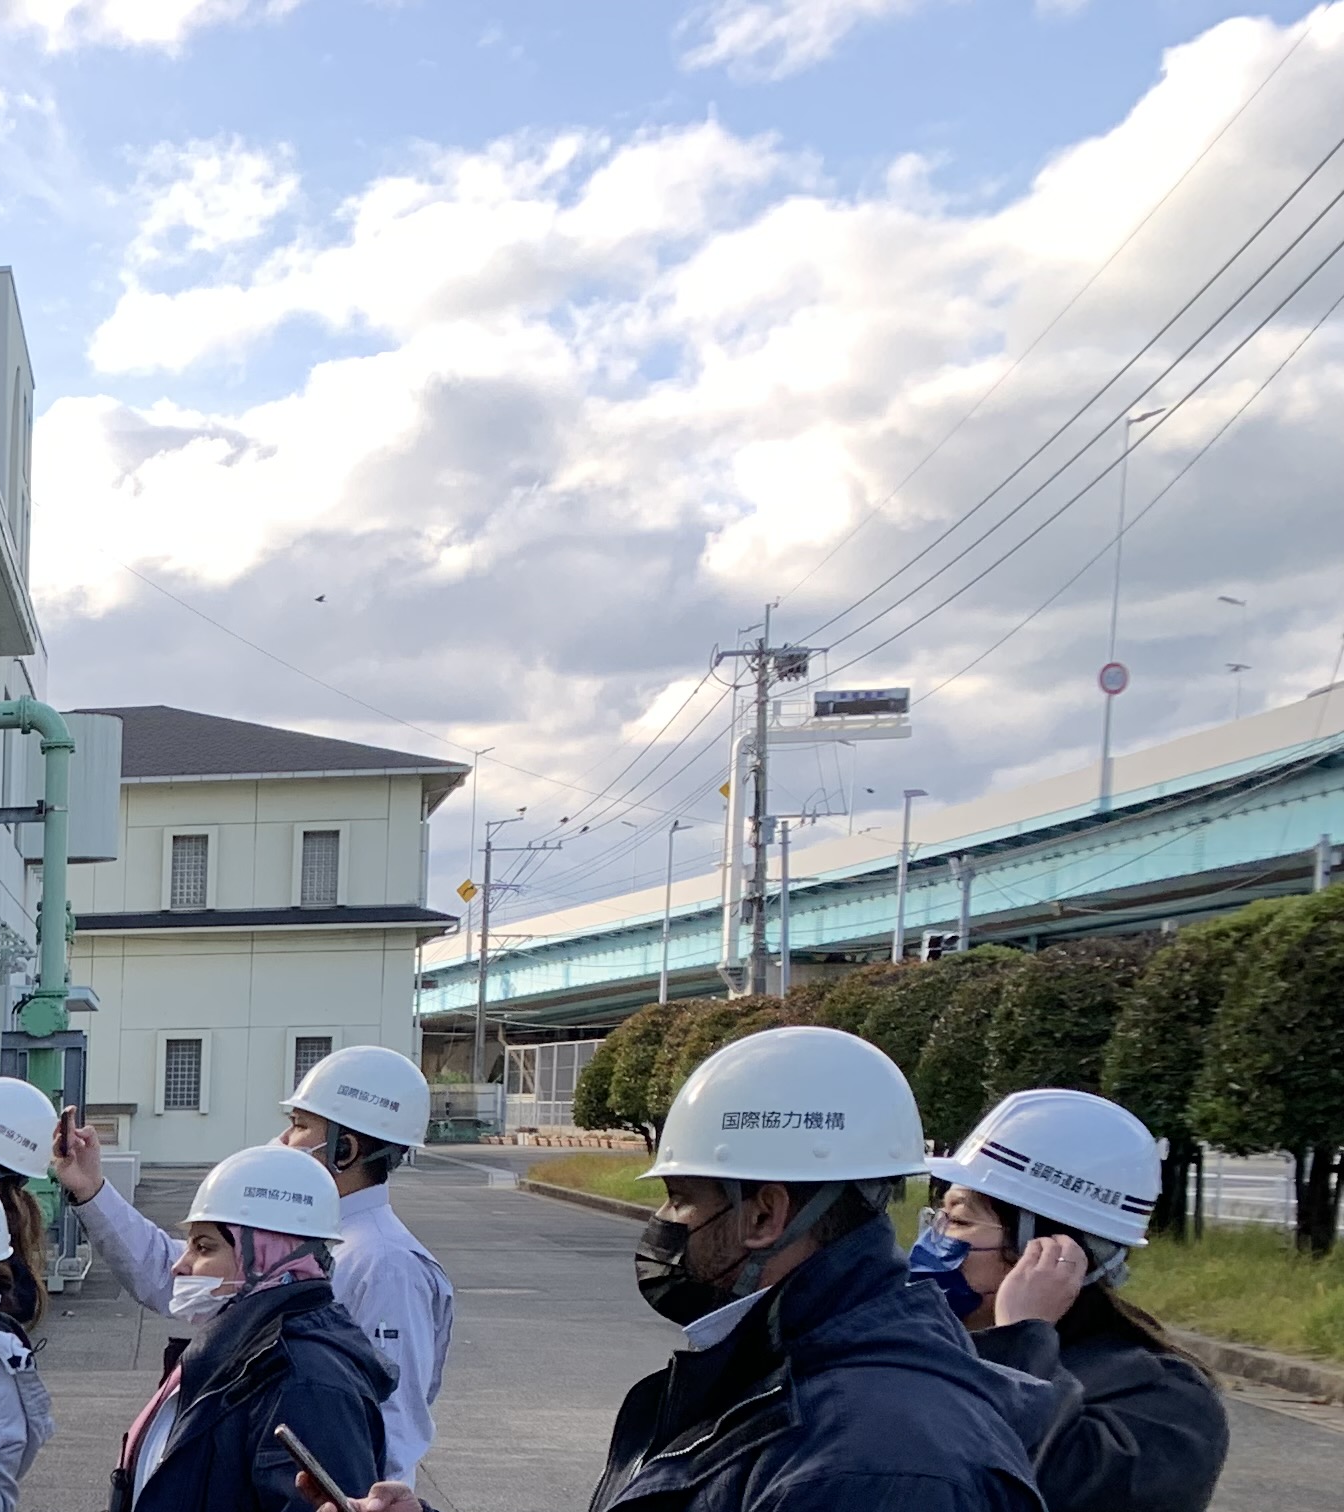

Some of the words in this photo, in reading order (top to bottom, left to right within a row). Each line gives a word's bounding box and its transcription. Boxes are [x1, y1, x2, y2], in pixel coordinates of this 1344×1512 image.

[337, 1084, 400, 1112] 国際協力機構
[721, 1111, 846, 1131] 国際協力機構
[1030, 1160, 1122, 1206] 福岡市道路下水道局
[243, 1186, 314, 1207] 国際協力機構
